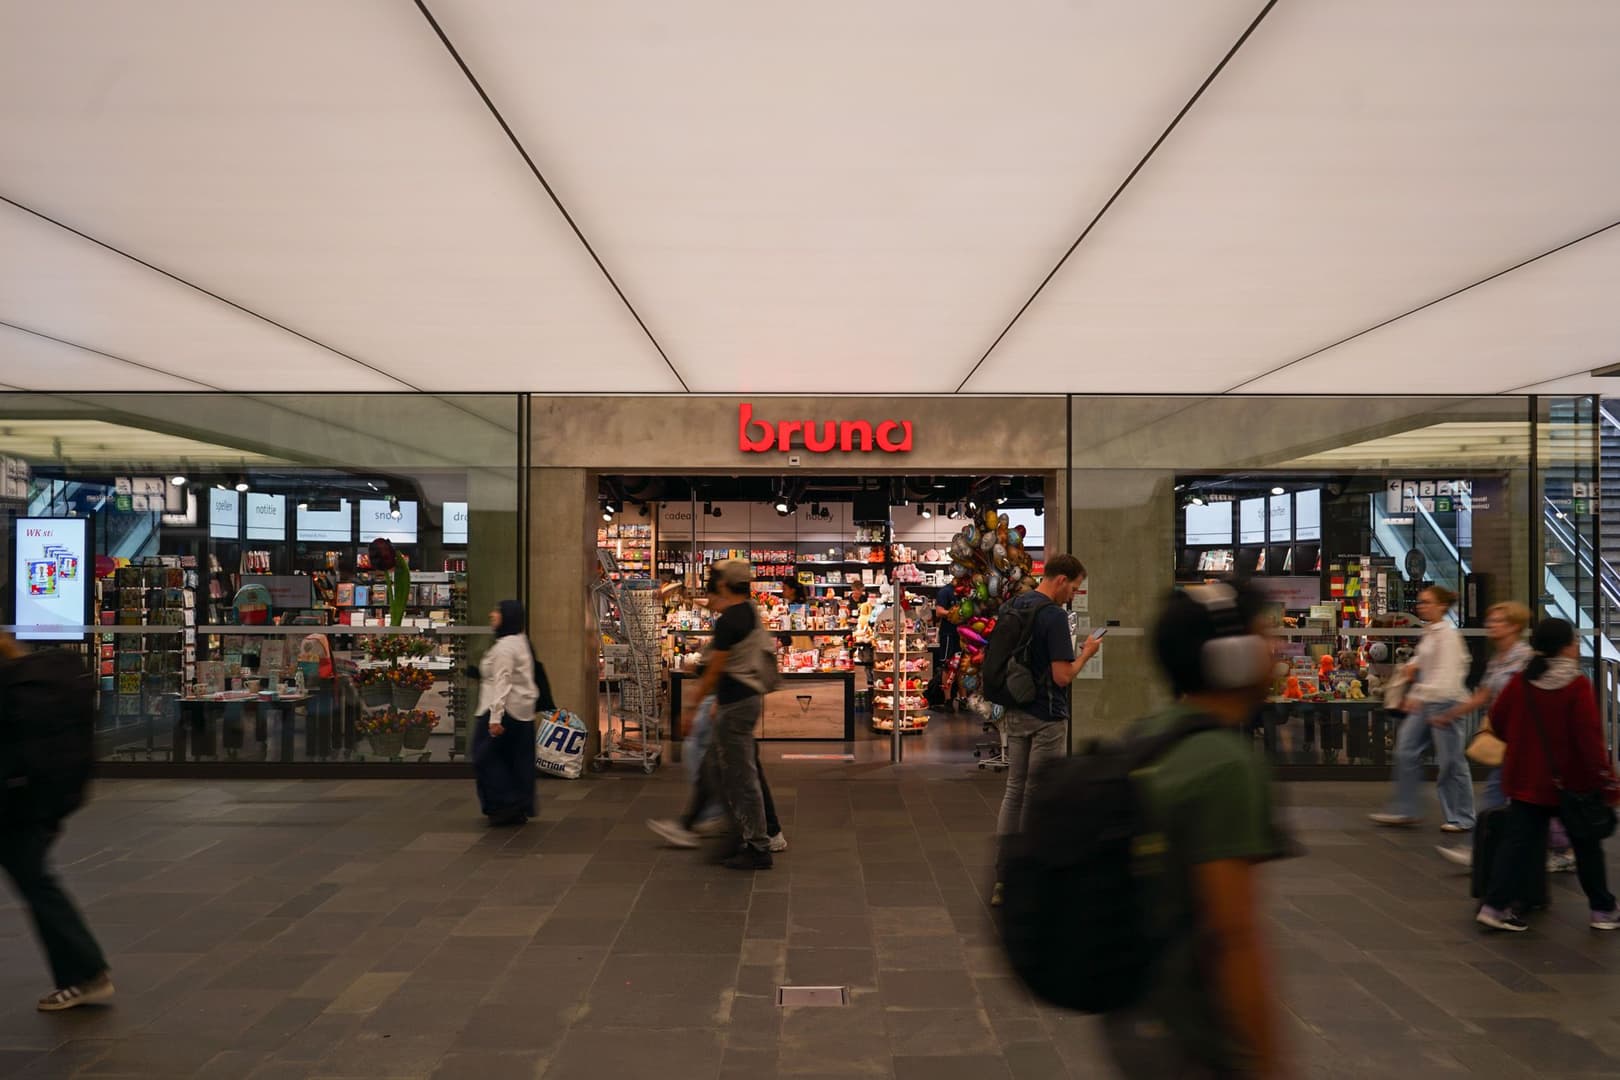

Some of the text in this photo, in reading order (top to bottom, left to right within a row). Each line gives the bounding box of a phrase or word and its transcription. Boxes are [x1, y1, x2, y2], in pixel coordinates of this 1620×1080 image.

[739, 403, 912, 452] bruna
[255, 504, 277, 515] notitie
[375, 511, 403, 523] snop
[26, 529, 42, 537] WK
[544, 726, 587, 754] AC
[535, 758, 566, 772] ACTION
